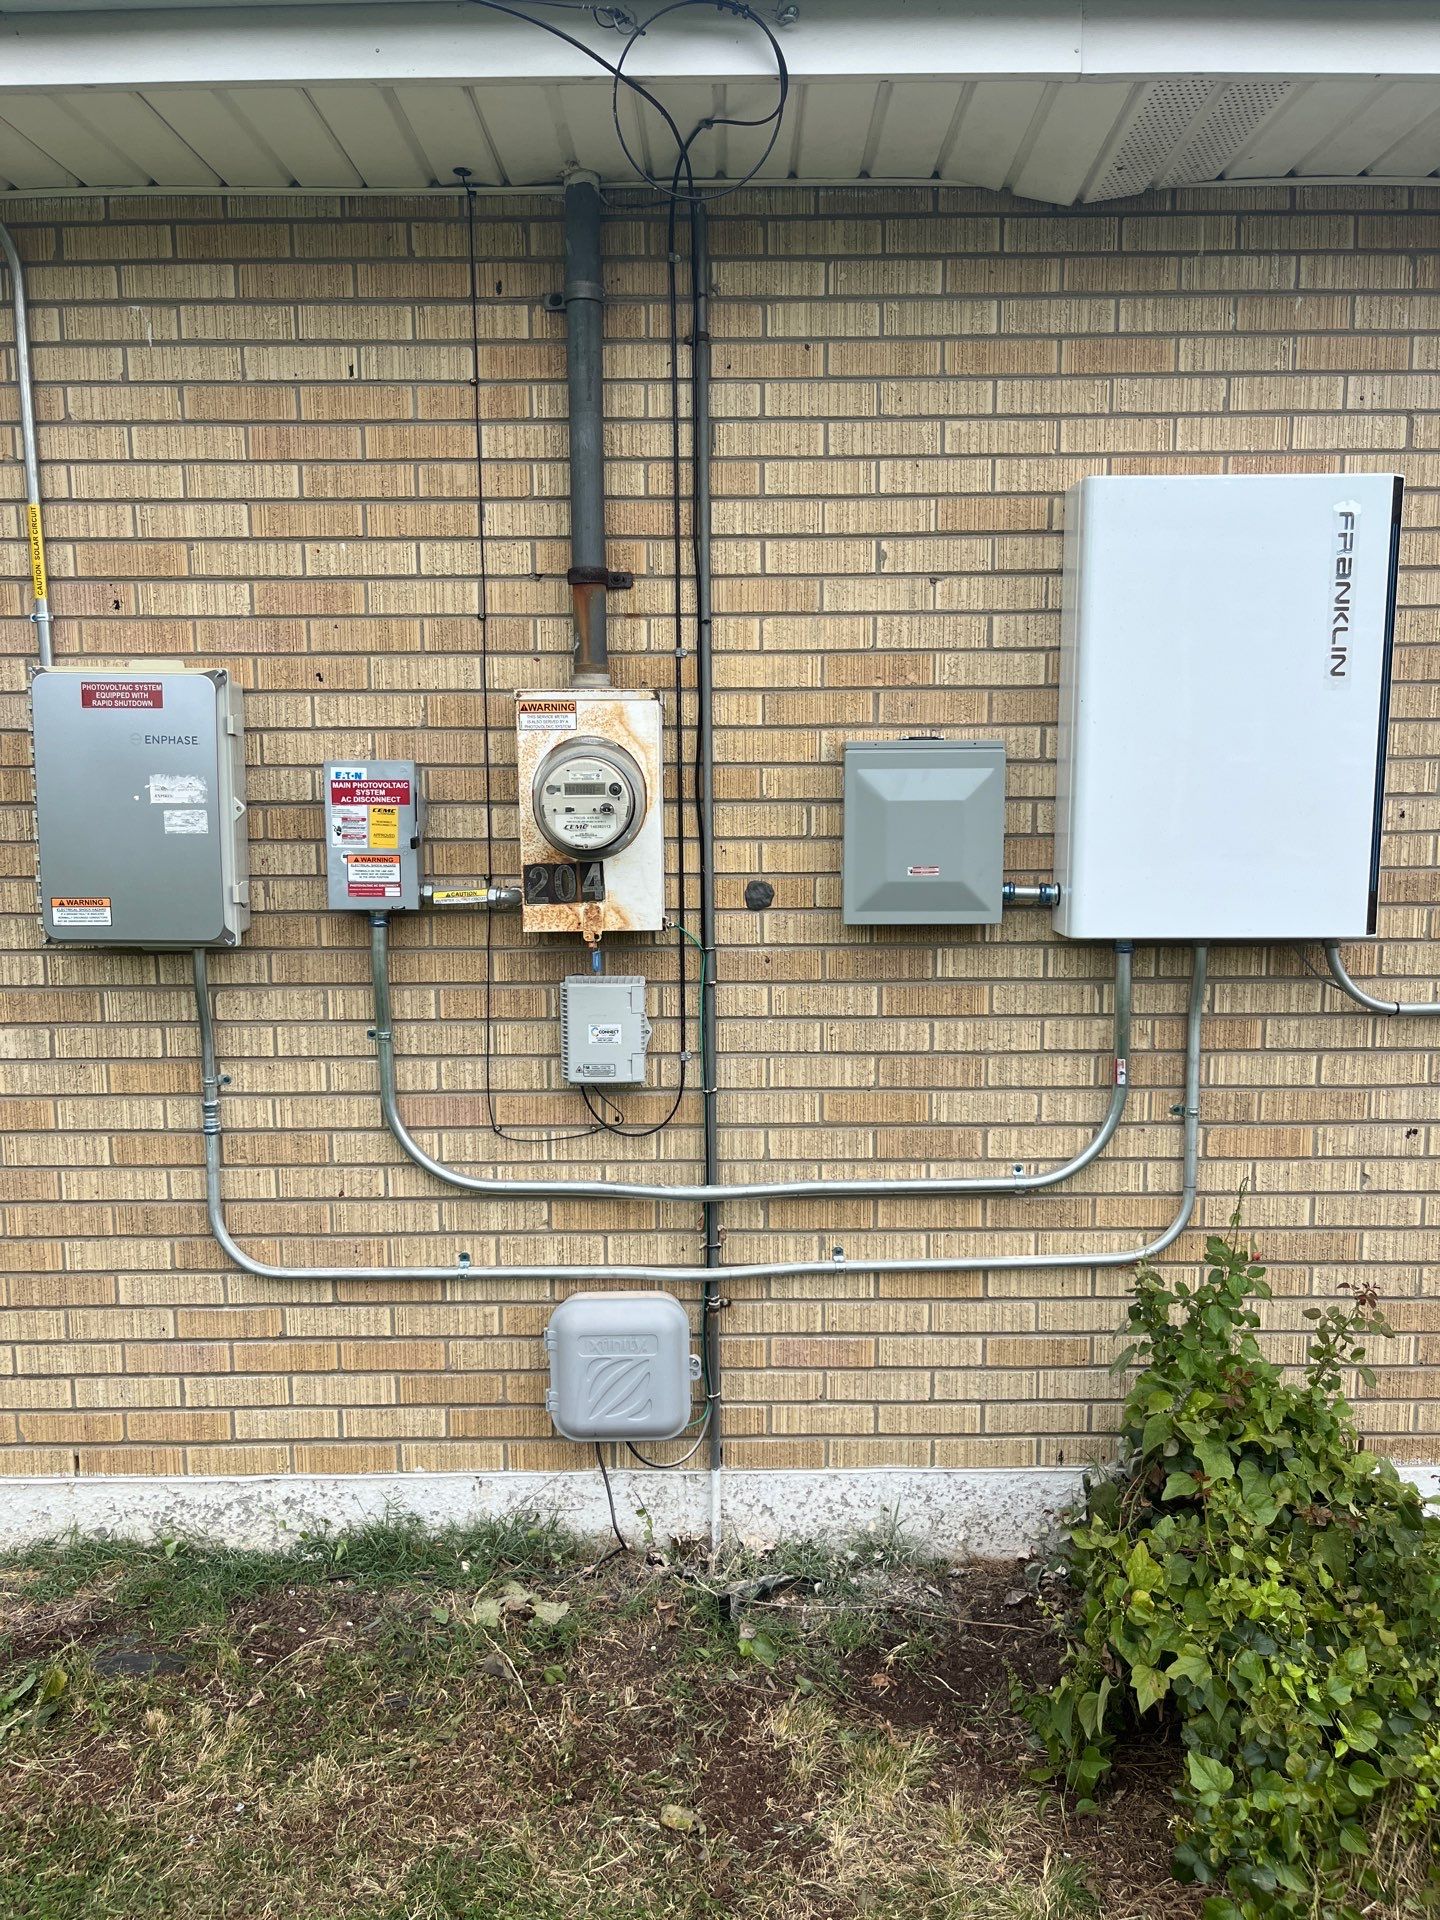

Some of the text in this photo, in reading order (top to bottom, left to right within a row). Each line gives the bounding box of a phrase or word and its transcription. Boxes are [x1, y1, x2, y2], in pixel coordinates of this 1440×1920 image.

[30, 507, 38, 535] CIRCUIT
[33, 536, 41, 560] SOLAR
[1330, 512, 1355, 677] FRANKLIN
[527, 703, 575, 711] WARNING
[144, 735, 199, 745] ENPHASE
[527, 863, 603, 902] 204
